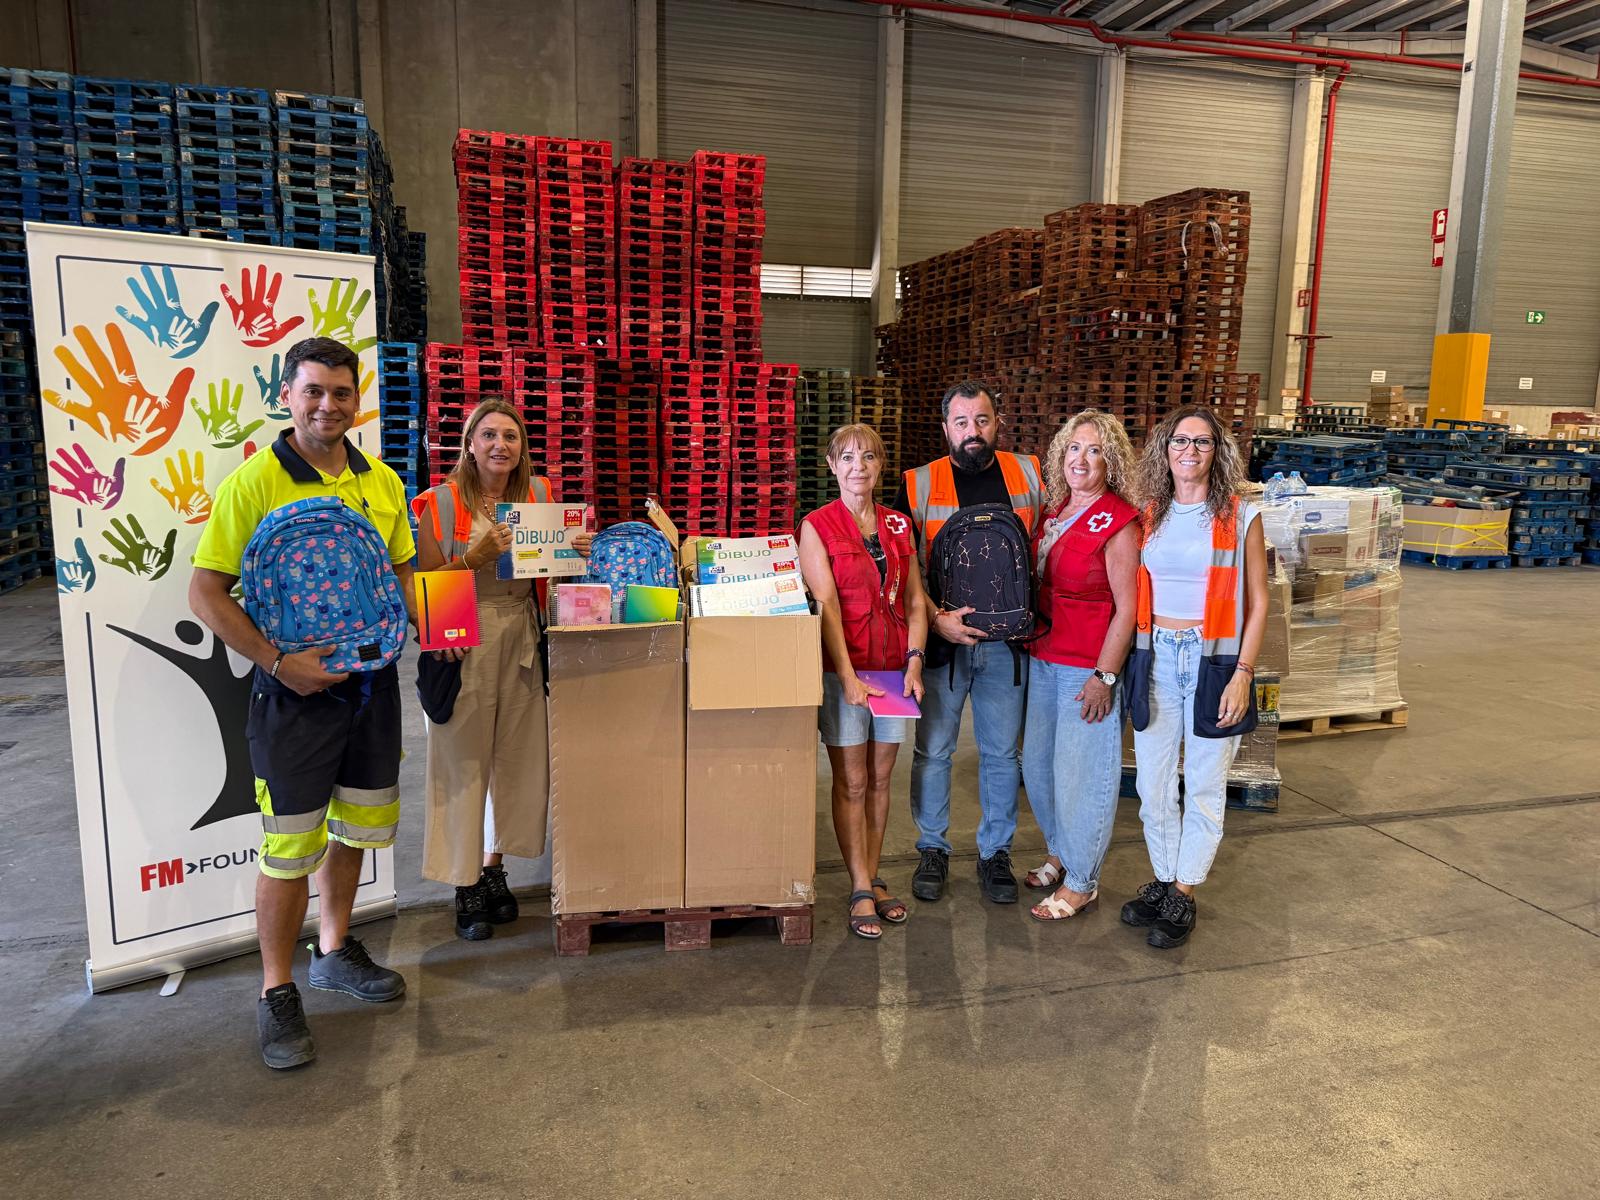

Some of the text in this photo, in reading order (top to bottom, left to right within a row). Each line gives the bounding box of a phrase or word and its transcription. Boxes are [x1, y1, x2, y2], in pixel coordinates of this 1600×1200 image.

[516, 530, 565, 545] DIBUJO
[718, 549, 771, 560] DIBUJO
[723, 595, 780, 609] DIBUJO
[140, 858, 184, 892] FM
